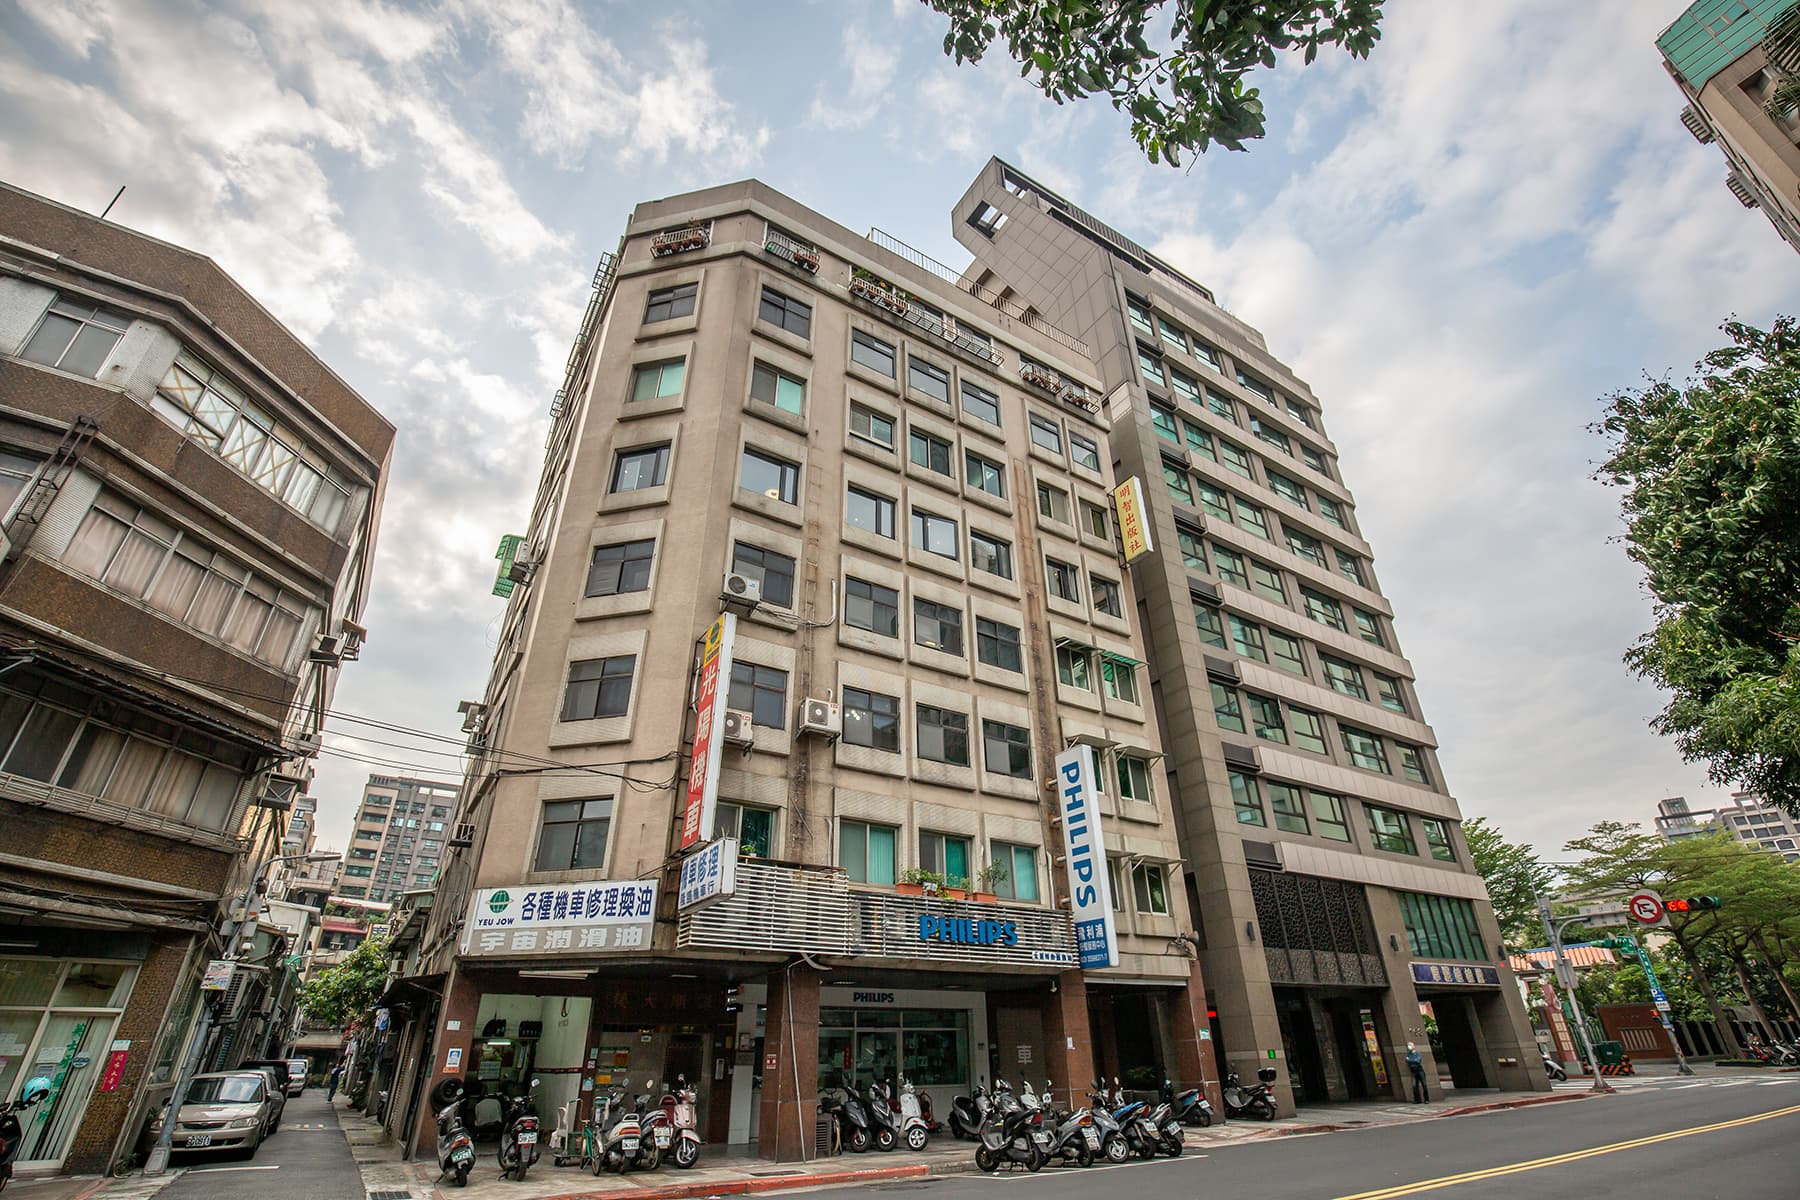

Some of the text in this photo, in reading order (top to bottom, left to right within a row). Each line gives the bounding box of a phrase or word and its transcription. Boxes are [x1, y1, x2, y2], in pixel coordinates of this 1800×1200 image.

[684, 664, 717, 839] 光陽機車
[1061, 761, 1097, 908] PHILIPS
[521, 885, 653, 921] 各種機車修理換油
[478, 917, 515, 926] YEU JOW
[919, 915, 1018, 946] PHILIPS
[479, 926, 643, 951] 宇宙潤滑油
[853, 992, 894, 1003] PHILIPS
